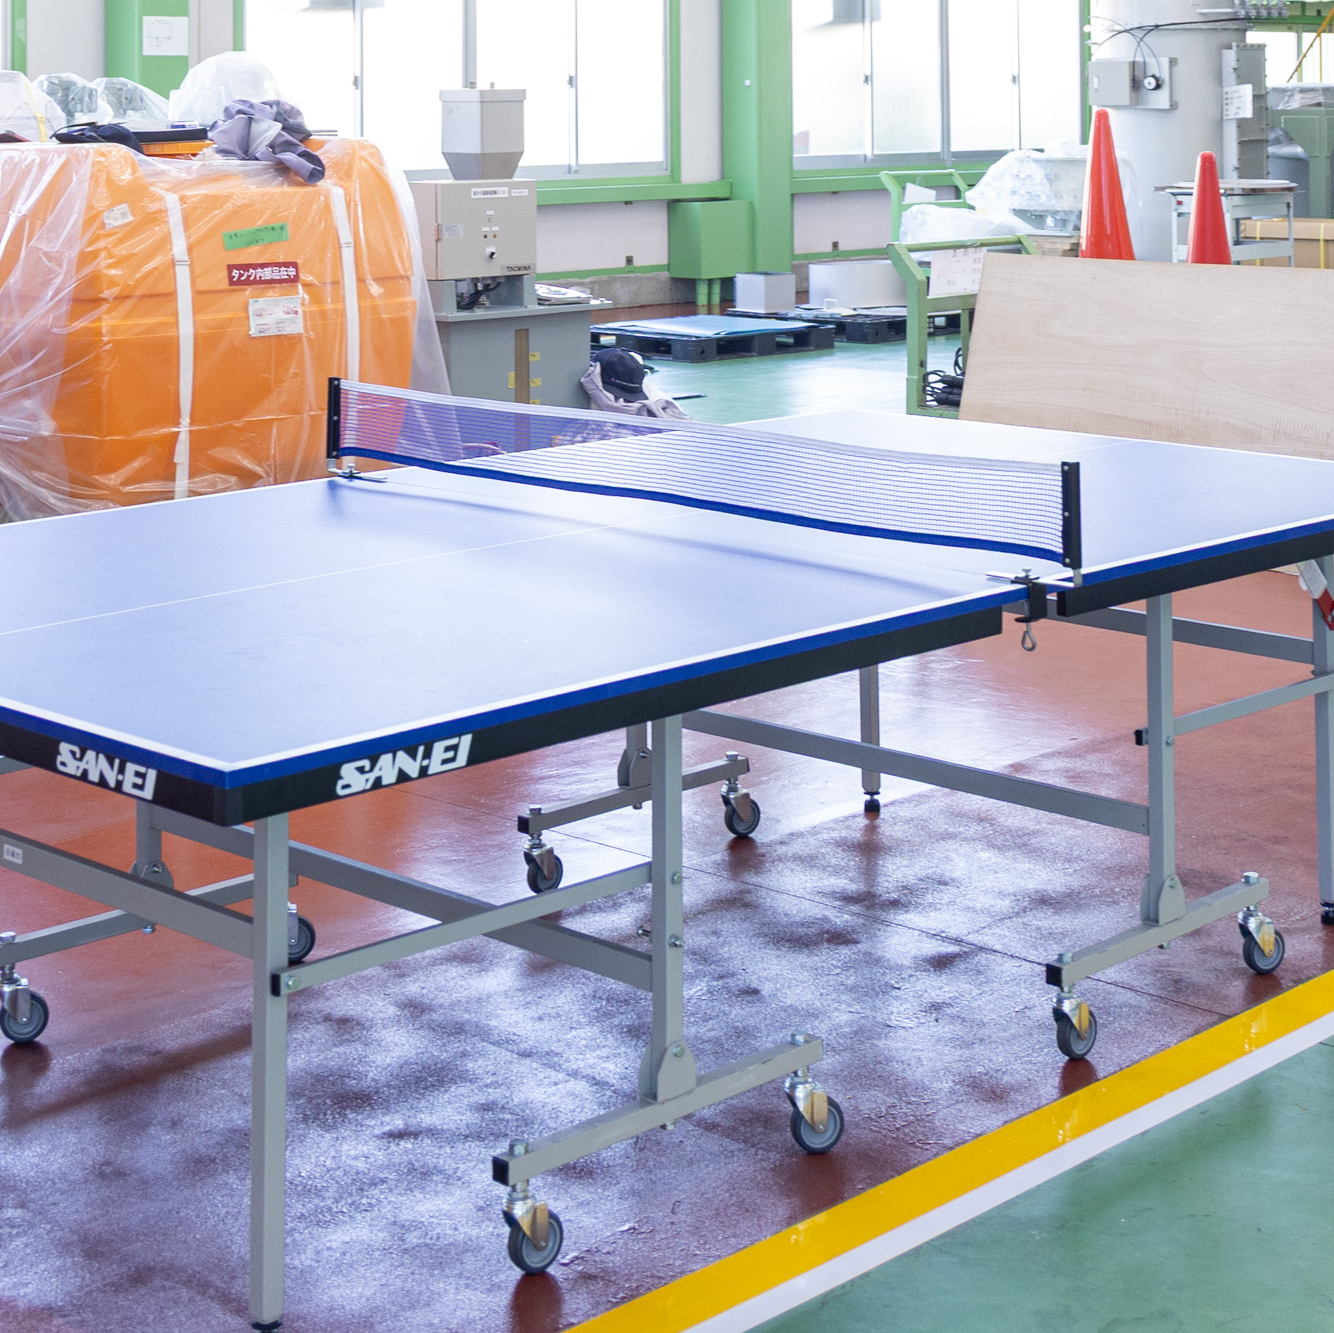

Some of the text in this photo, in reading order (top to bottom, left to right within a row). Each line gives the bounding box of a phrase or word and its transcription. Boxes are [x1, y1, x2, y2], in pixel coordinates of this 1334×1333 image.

[231, 266, 297, 282] タンク内部品在中
